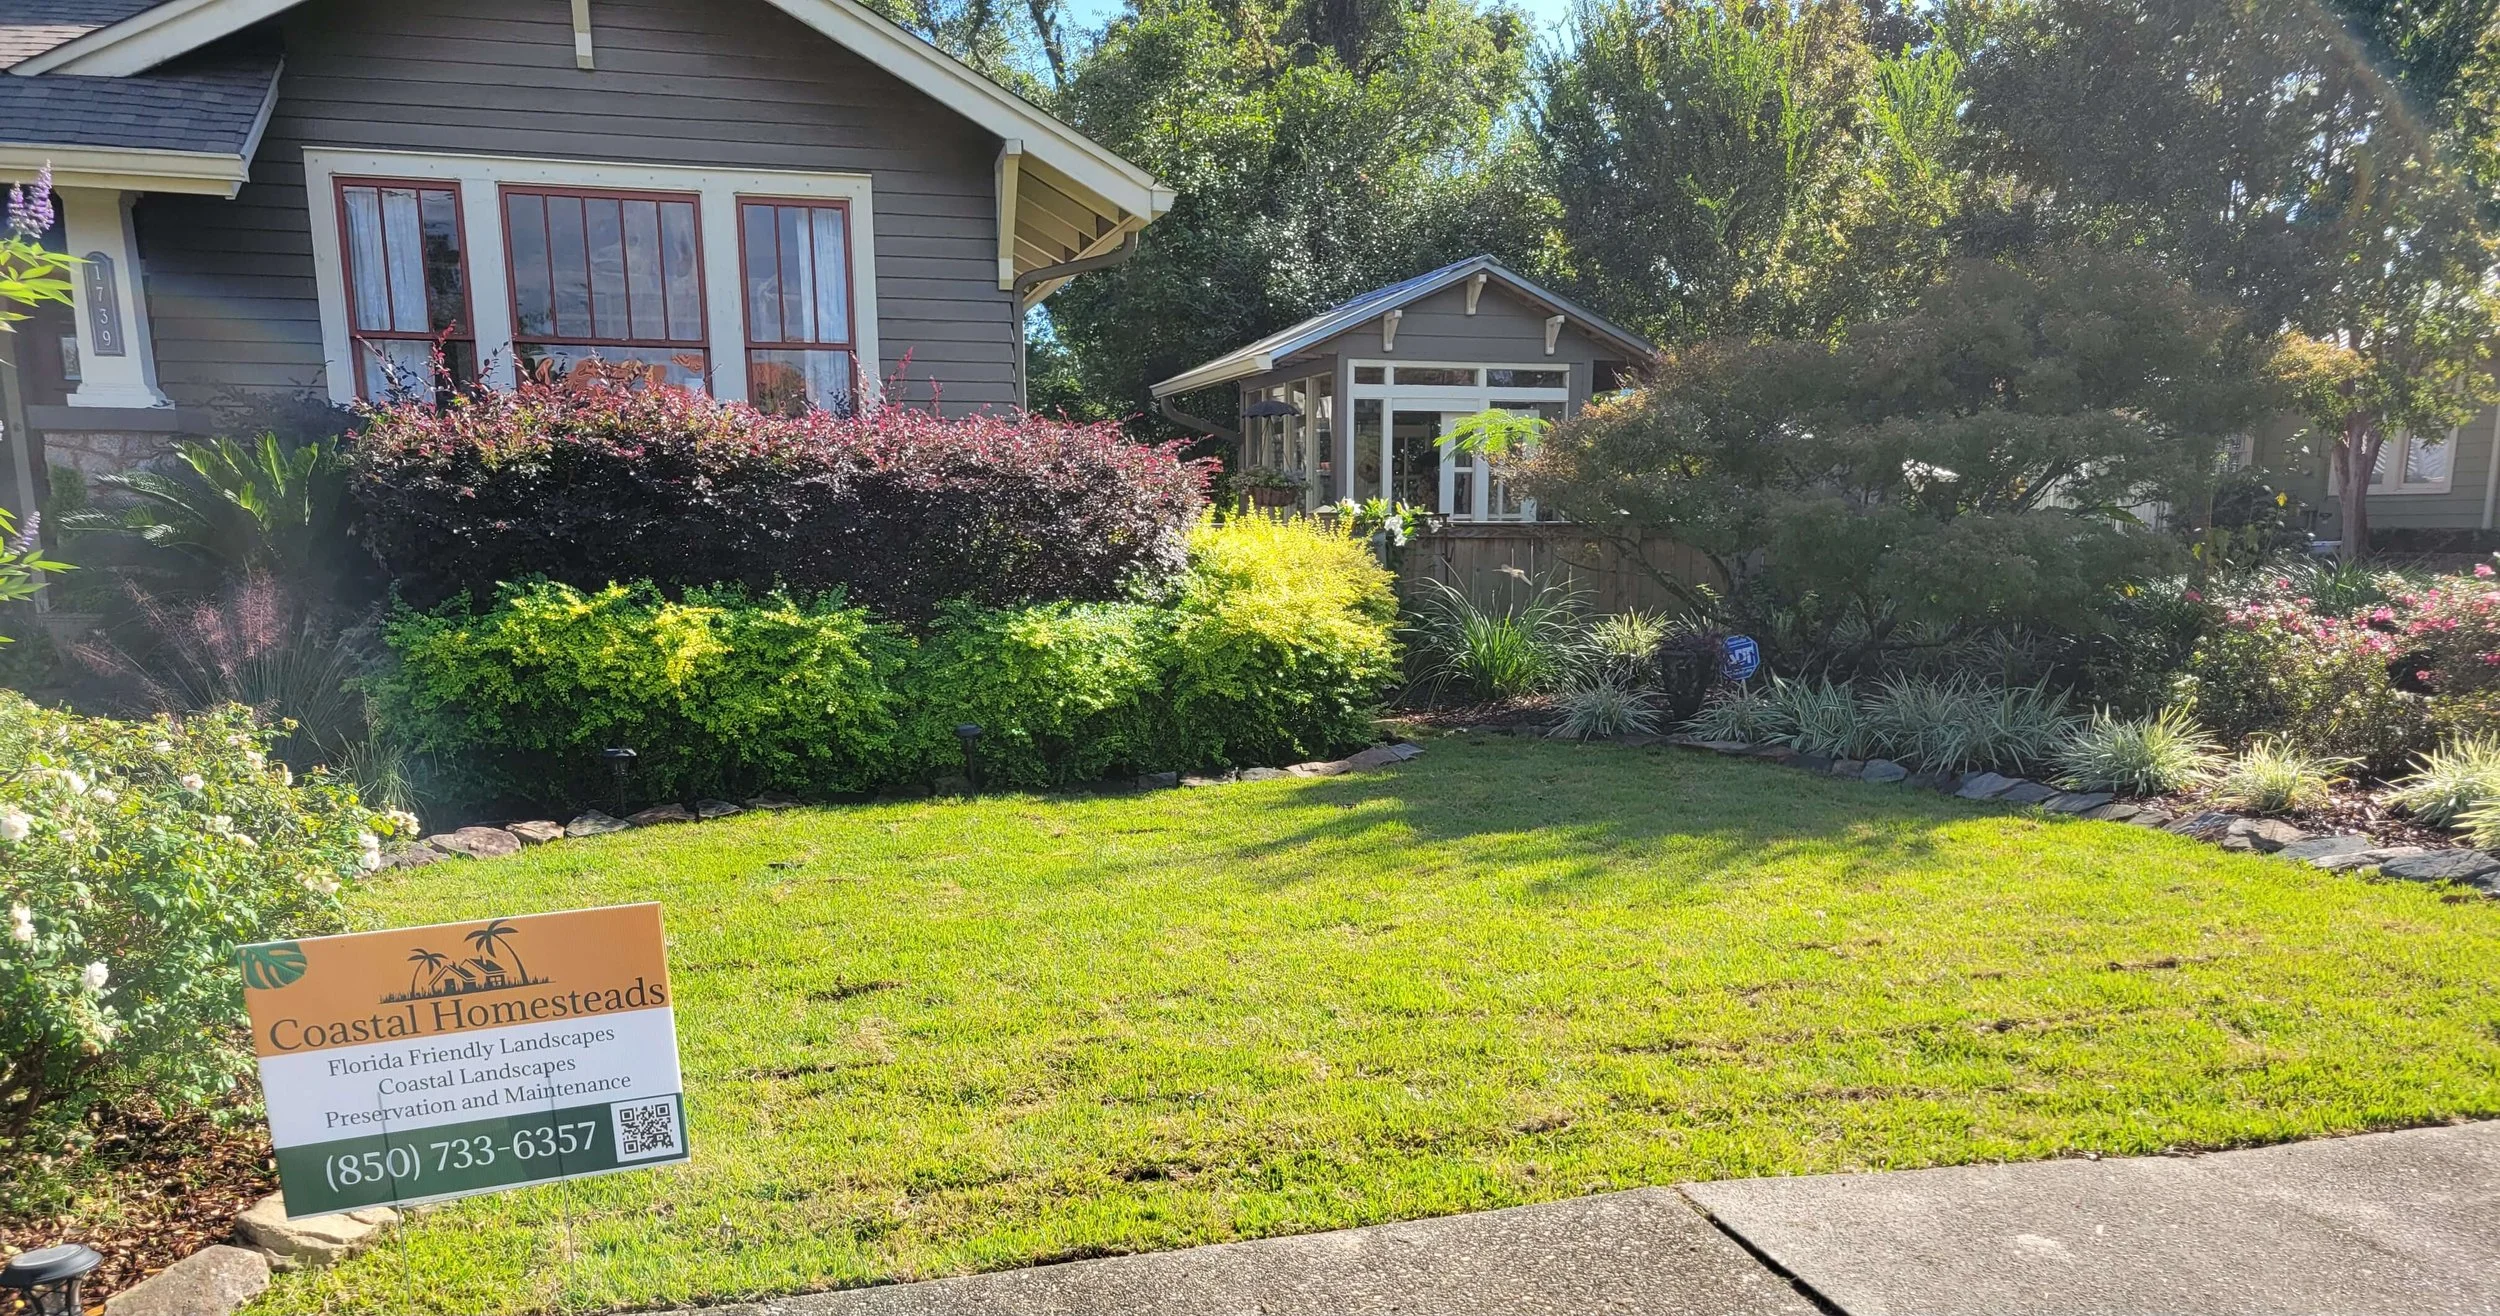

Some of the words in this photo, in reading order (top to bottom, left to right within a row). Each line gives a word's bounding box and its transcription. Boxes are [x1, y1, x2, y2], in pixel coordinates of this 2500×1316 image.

[269, 1005, 418, 1051] Coastal
[431, 977, 666, 1032] Homesteads
[328, 1052, 404, 1077] Florida
[409, 1040, 495, 1067] Friendly
[500, 1026, 615, 1054] Landscapes
[378, 1072, 454, 1096] Coastal
[460, 1057, 576, 1085] Landscapes
[326, 1099, 457, 1129] Preservation
[462, 1092, 499, 1111] and
[504, 1074, 632, 1105] Maintenance
[326, 1143, 422, 1192] (850)
[430, 1121, 596, 1172] 733-6357
